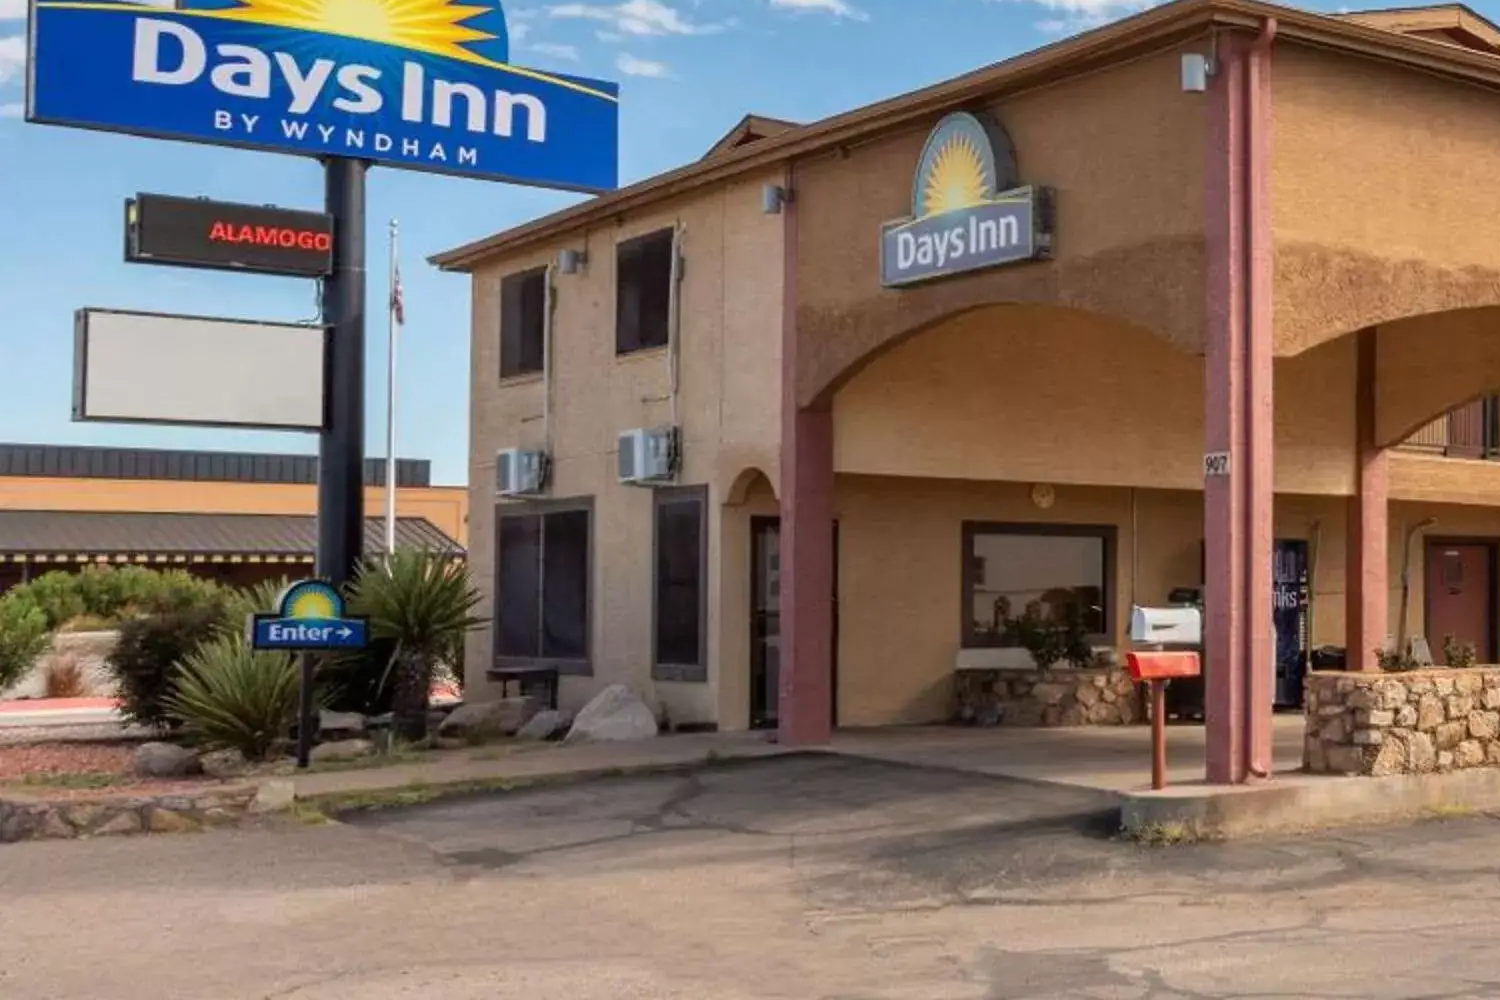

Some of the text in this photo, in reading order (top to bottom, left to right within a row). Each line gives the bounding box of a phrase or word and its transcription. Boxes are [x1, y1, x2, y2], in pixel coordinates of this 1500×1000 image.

[132, 17, 546, 142] Days Inn
[214, 109, 477, 165] BY WYNDHAM
[209, 220, 331, 250] ALAMOGO
[897, 214, 1018, 270] Days Inn
[1205, 455, 1228, 472] 907
[1272, 584, 1298, 610] nks
[268, 623, 333, 641] Enter
